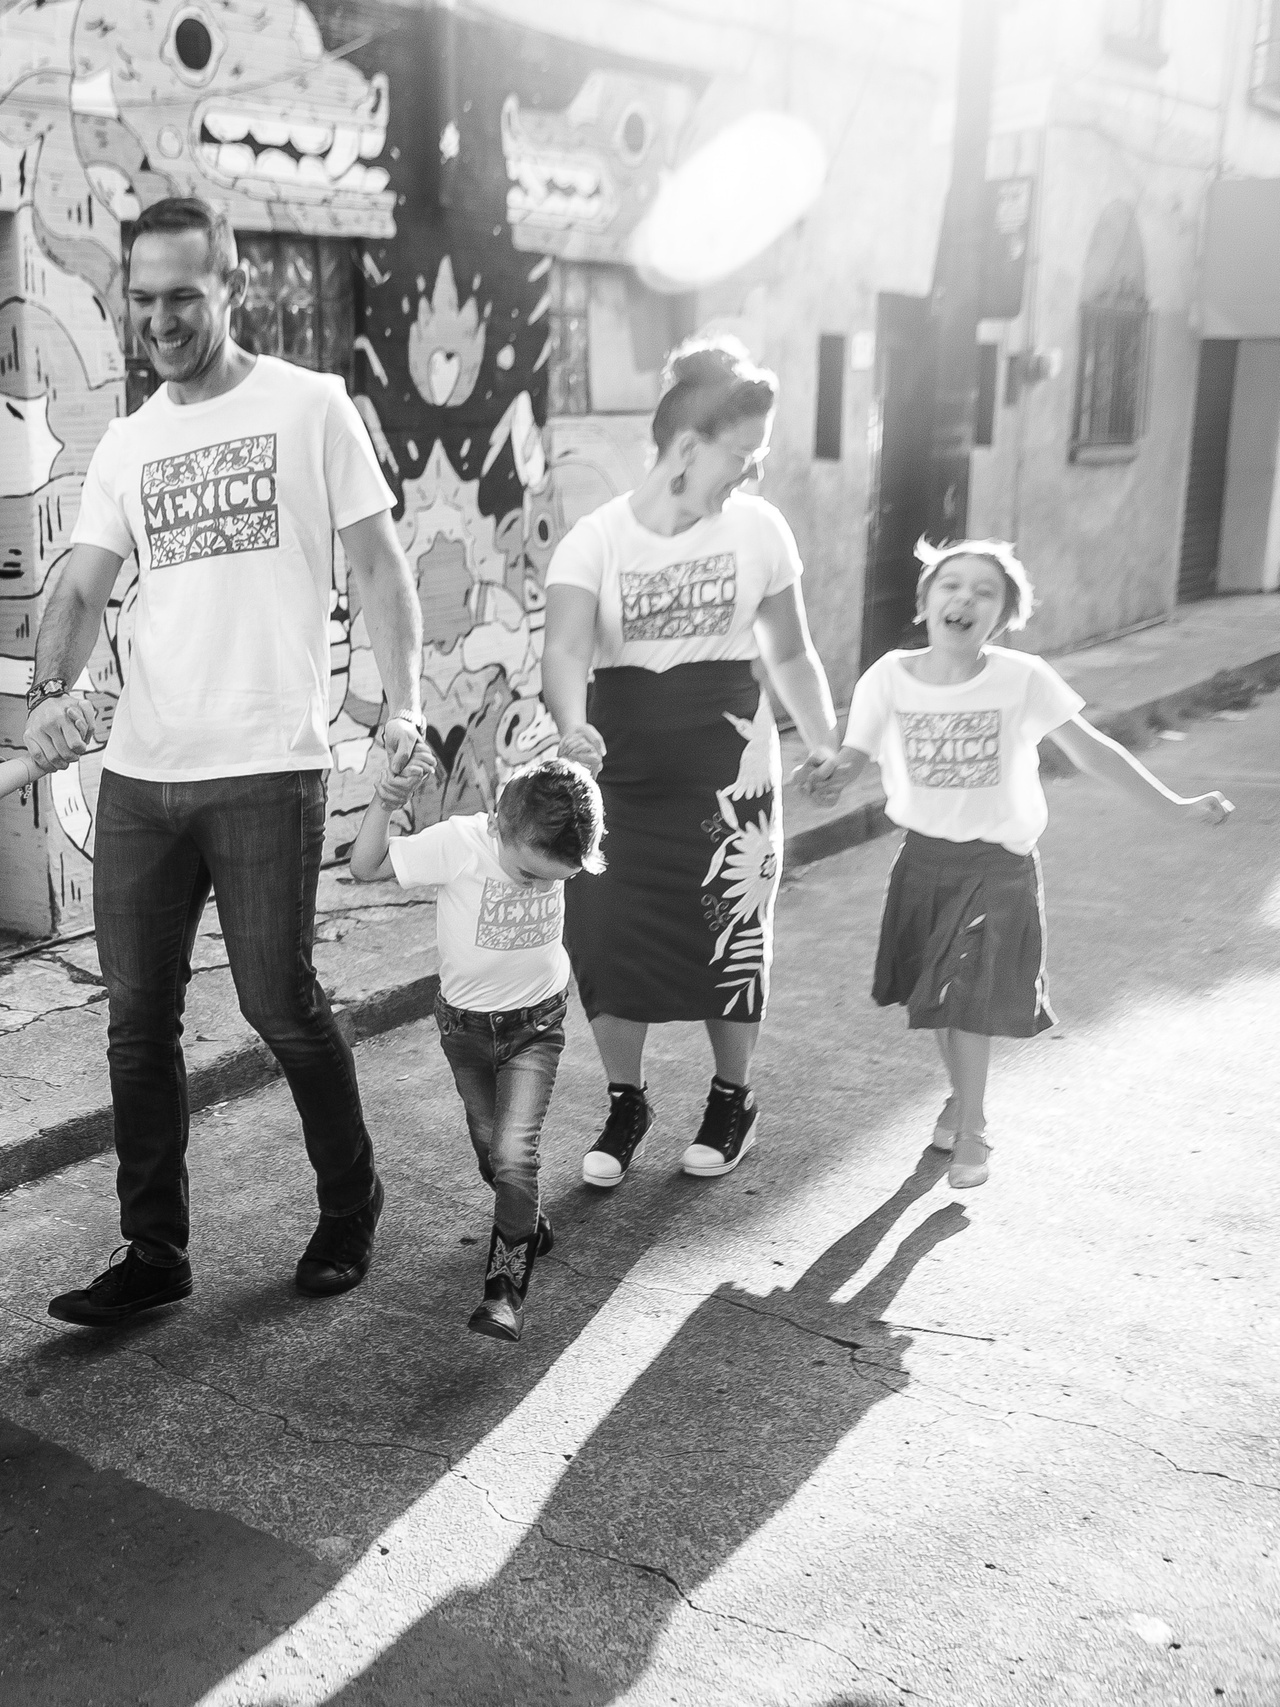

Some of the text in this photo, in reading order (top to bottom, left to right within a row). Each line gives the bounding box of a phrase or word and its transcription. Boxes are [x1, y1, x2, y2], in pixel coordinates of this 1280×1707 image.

[141, 472, 277, 533] MEXICO
[620, 576, 736, 621] MEXICO
[902, 736, 999, 763] EXICO
[480, 896, 562, 924] MEXIC
